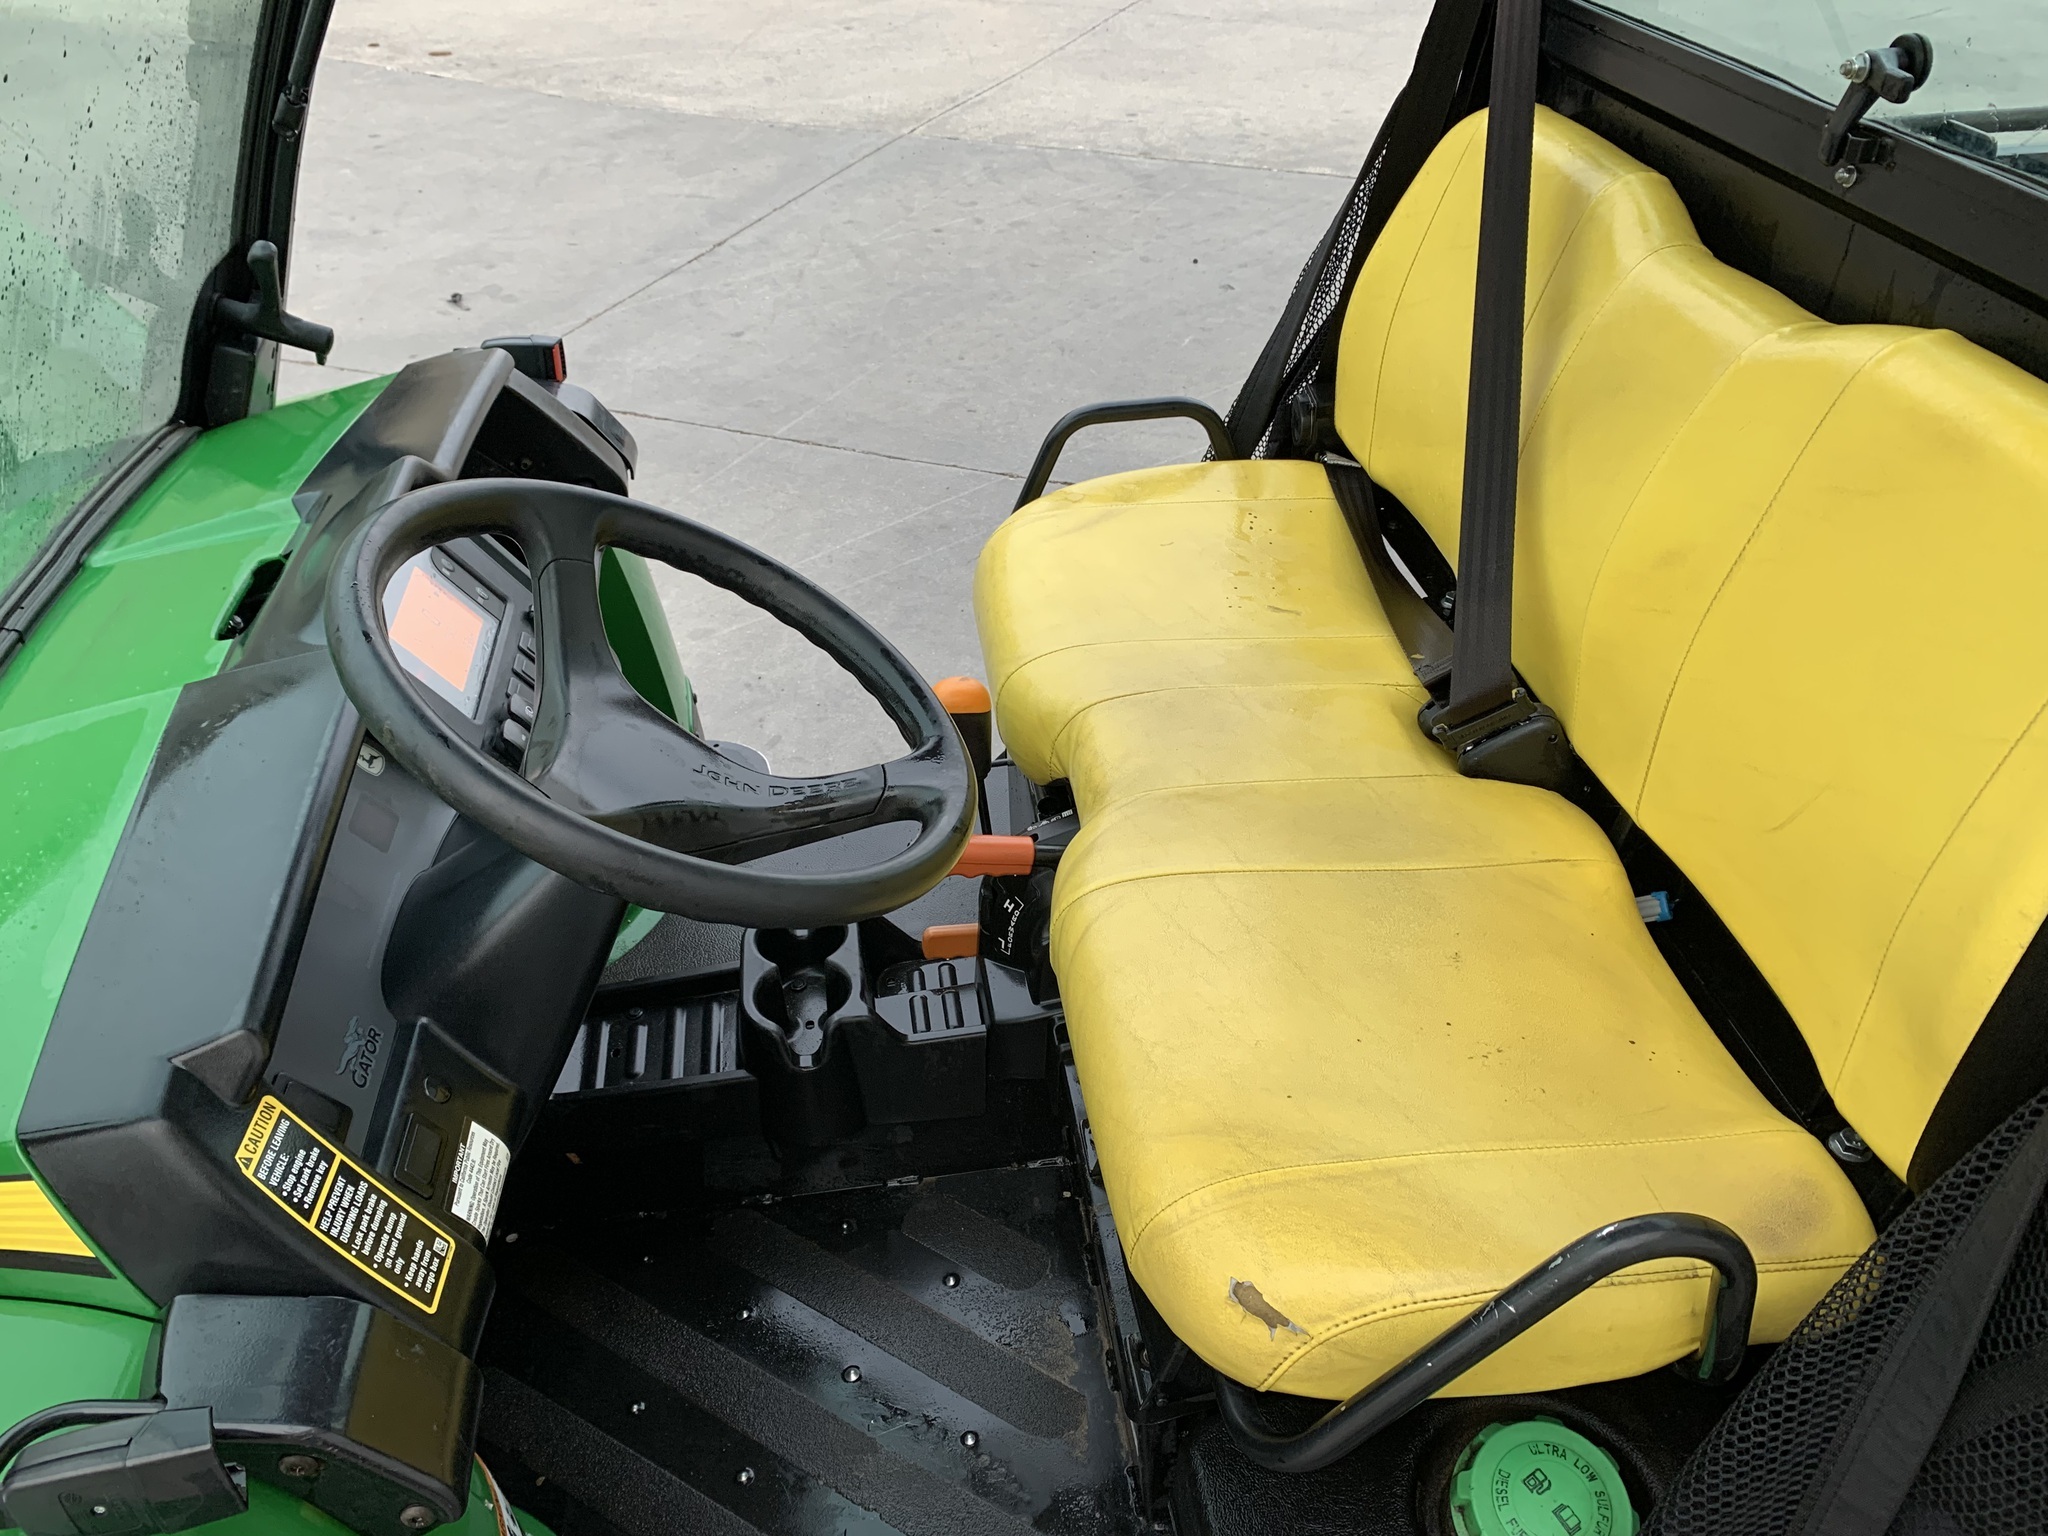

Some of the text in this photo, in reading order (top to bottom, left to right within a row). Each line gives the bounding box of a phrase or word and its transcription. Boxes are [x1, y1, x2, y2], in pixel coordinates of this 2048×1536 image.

[692, 764, 862, 798] JOHN DEERE
[1003, 898, 1015, 913] H
[1007, 909, 1021, 949] FORWARD
[352, 1027, 382, 1089] GATOR
[244, 1102, 276, 1154] CAUTION
[257, 1119, 290, 1180] BEFORE LEAVING
[269, 1153, 289, 1186] VEHICLE:
[282, 1149, 306, 1192] Stop engine
[293, 1147, 320, 1198] Set park brake
[304, 1160, 328, 1204] Remove key
[452, 1143, 465, 1183] IMPORTANT
[320, 1176, 346, 1231] HELP PREVENT
[330, 1185, 355, 1237] INJURY WHEN
[340, 1181, 368, 1243] DUMPING LOADS
[352, 1194, 377, 1250] Lock park brake
[361, 1200, 388, 1255] before dumping
[374, 1212, 397, 1262] Operate dump
[385, 1212, 407, 1268] on level ground
[394, 1257, 405, 1274] only
[405, 1240, 424, 1282] Keep hands
[415, 1249, 431, 1288] away from
[424, 1257, 439, 1293] cargo box
[1528, 1443, 1567, 1460] ULTRA
[1573, 1458, 1598, 1483] LOW
[1495, 1468, 1511, 1512] DIESEL
